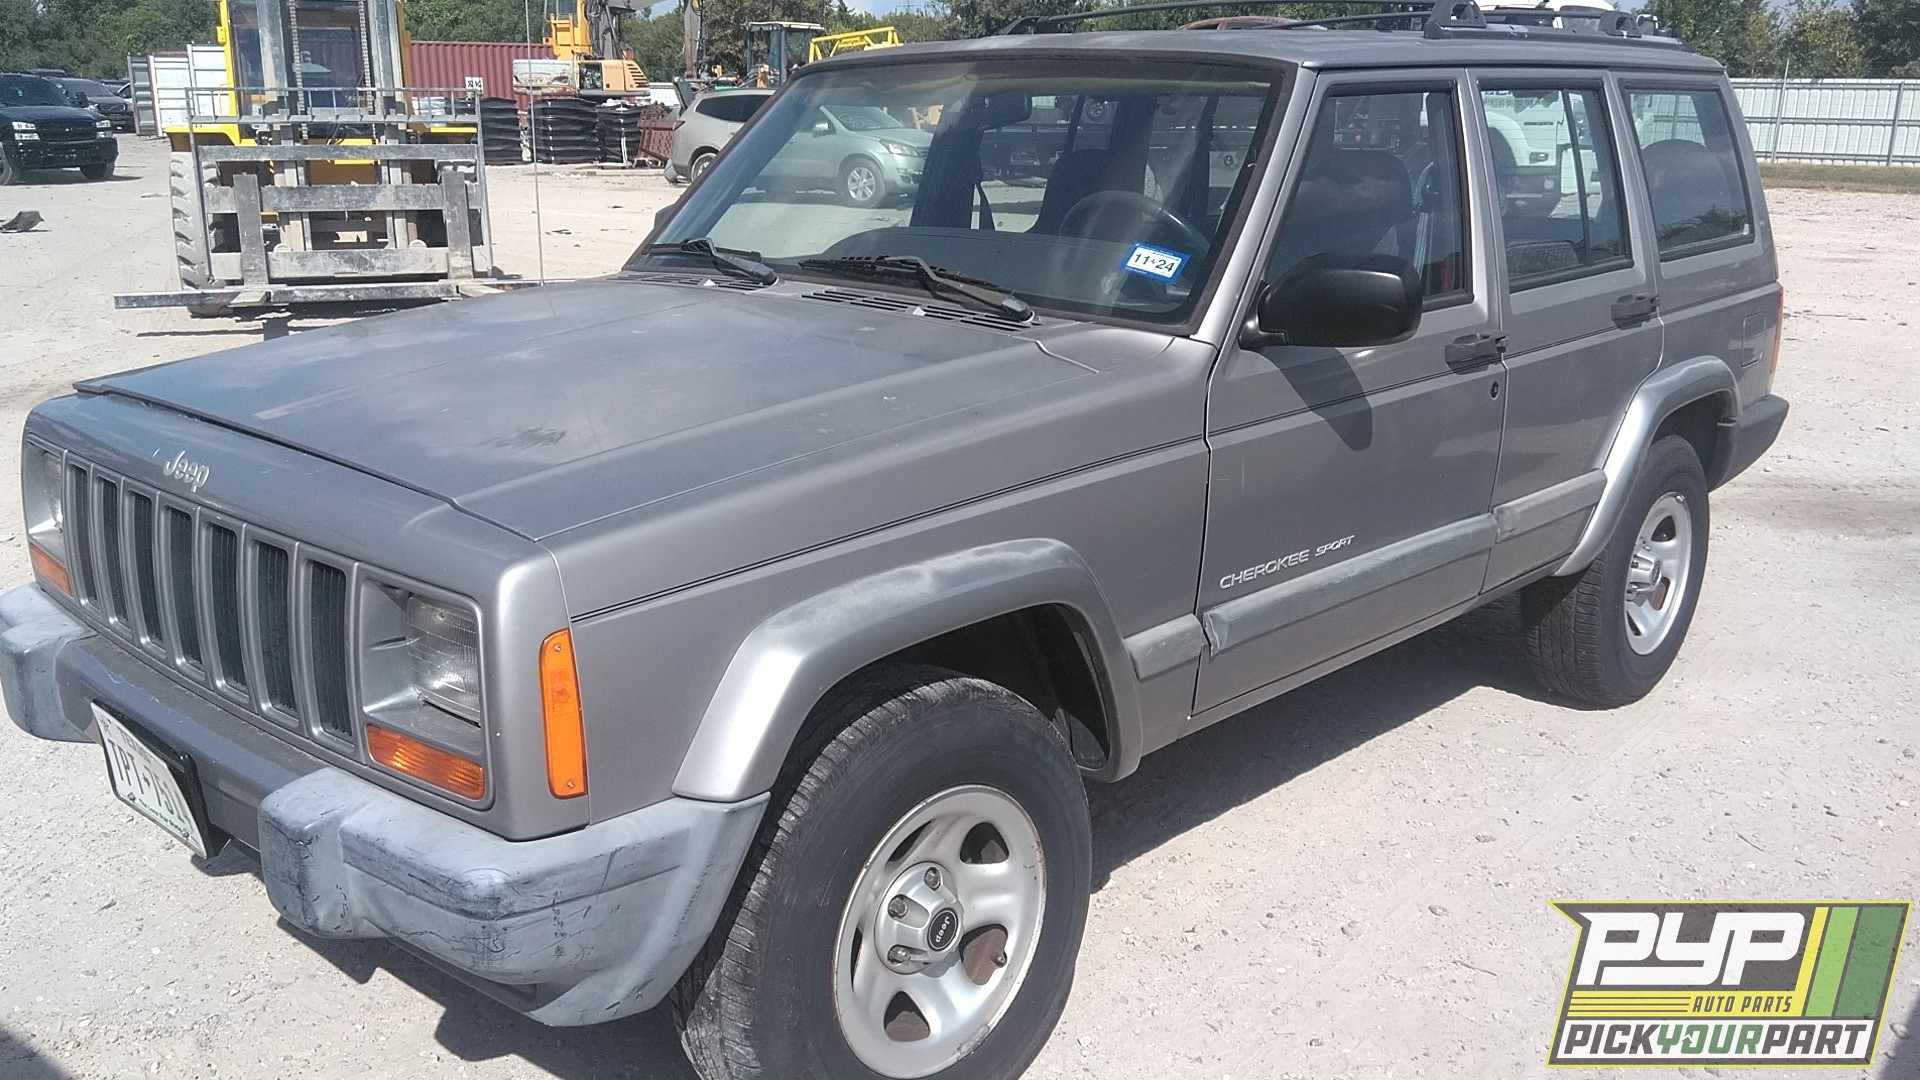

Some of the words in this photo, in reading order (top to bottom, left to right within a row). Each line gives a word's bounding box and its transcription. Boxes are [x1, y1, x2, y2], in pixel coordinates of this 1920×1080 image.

[163, 450, 209, 493] Jeep
[1219, 549, 1310, 590] CHEROKEE
[1315, 535, 1355, 557] SPORT
[935, 916, 950, 943] Jeep
